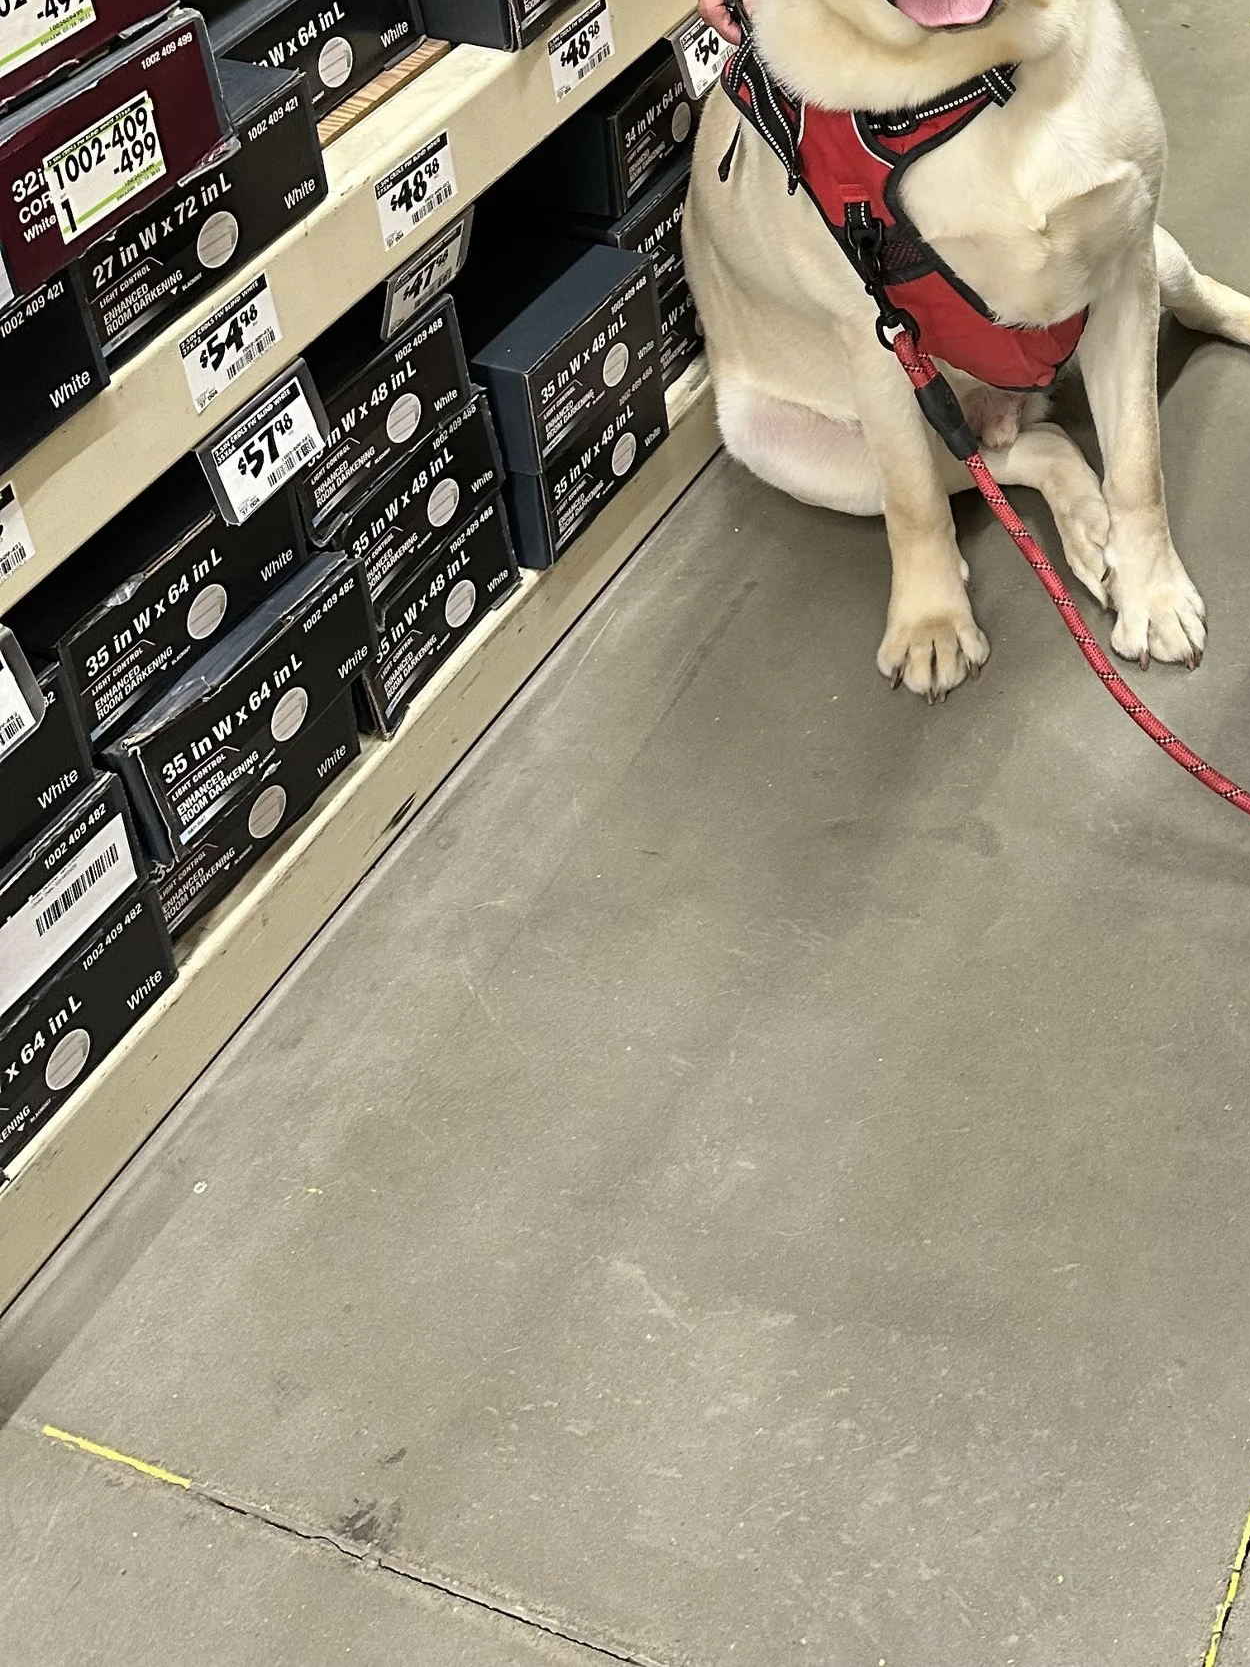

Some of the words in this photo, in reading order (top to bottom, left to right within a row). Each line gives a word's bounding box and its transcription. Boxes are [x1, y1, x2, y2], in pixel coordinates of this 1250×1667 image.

[141, 51, 161, 70] 1002
[162, 42, 176, 57] 409
[177, 32, 193, 48] 499
[248, 123, 267, 142] 1002
[268, 108, 284, 127] 409
[284, 95, 299, 114] 421
[53, 107, 147, 191] 1002-409
[113, 131, 156, 176] -499
[61, 199, 77, 233] 1
[284, 178, 316, 210] White
[23, 215, 57, 243] White
[92, 256, 115, 288] 27
[119, 242, 140, 268] in
[138, 222, 158, 252] W
[160, 220, 173, 236] x
[174, 195, 199, 225] 72
[201, 182, 220, 207] in
[219, 172, 232, 193] L
[100, 289, 118, 309] LIGHT
[119, 265, 151, 295] CONTROL
[103, 284, 149, 325] ENHANCED
[106, 308, 133, 336] ROOM
[132, 270, 183, 317] DARKENING
[50, 370, 91, 409] White
[257, 405, 273, 424] BLIND
[273, 389, 291, 409] WHITE
[302, 611, 322, 633] 1002
[322, 594, 338, 614] 409
[338, 578, 355, 599] 482
[338, 644, 369, 679] White
[162, 754, 188, 784] 35
[191, 737, 213, 761] in
[211, 716, 233, 744] W
[236, 708, 249, 724] x
[249, 681, 272, 711] 64
[274, 667, 292, 689] in
[291, 653, 303, 675] L
[38, 768, 79, 809] White
[172, 783, 192, 802] LIGHT
[192, 753, 227, 785] CONTROL
[177, 770, 224, 816] ENHANCED
[180, 796, 209, 825] ROOM
[208, 750, 260, 800] DARKENING
[127, 968, 163, 1012] White
